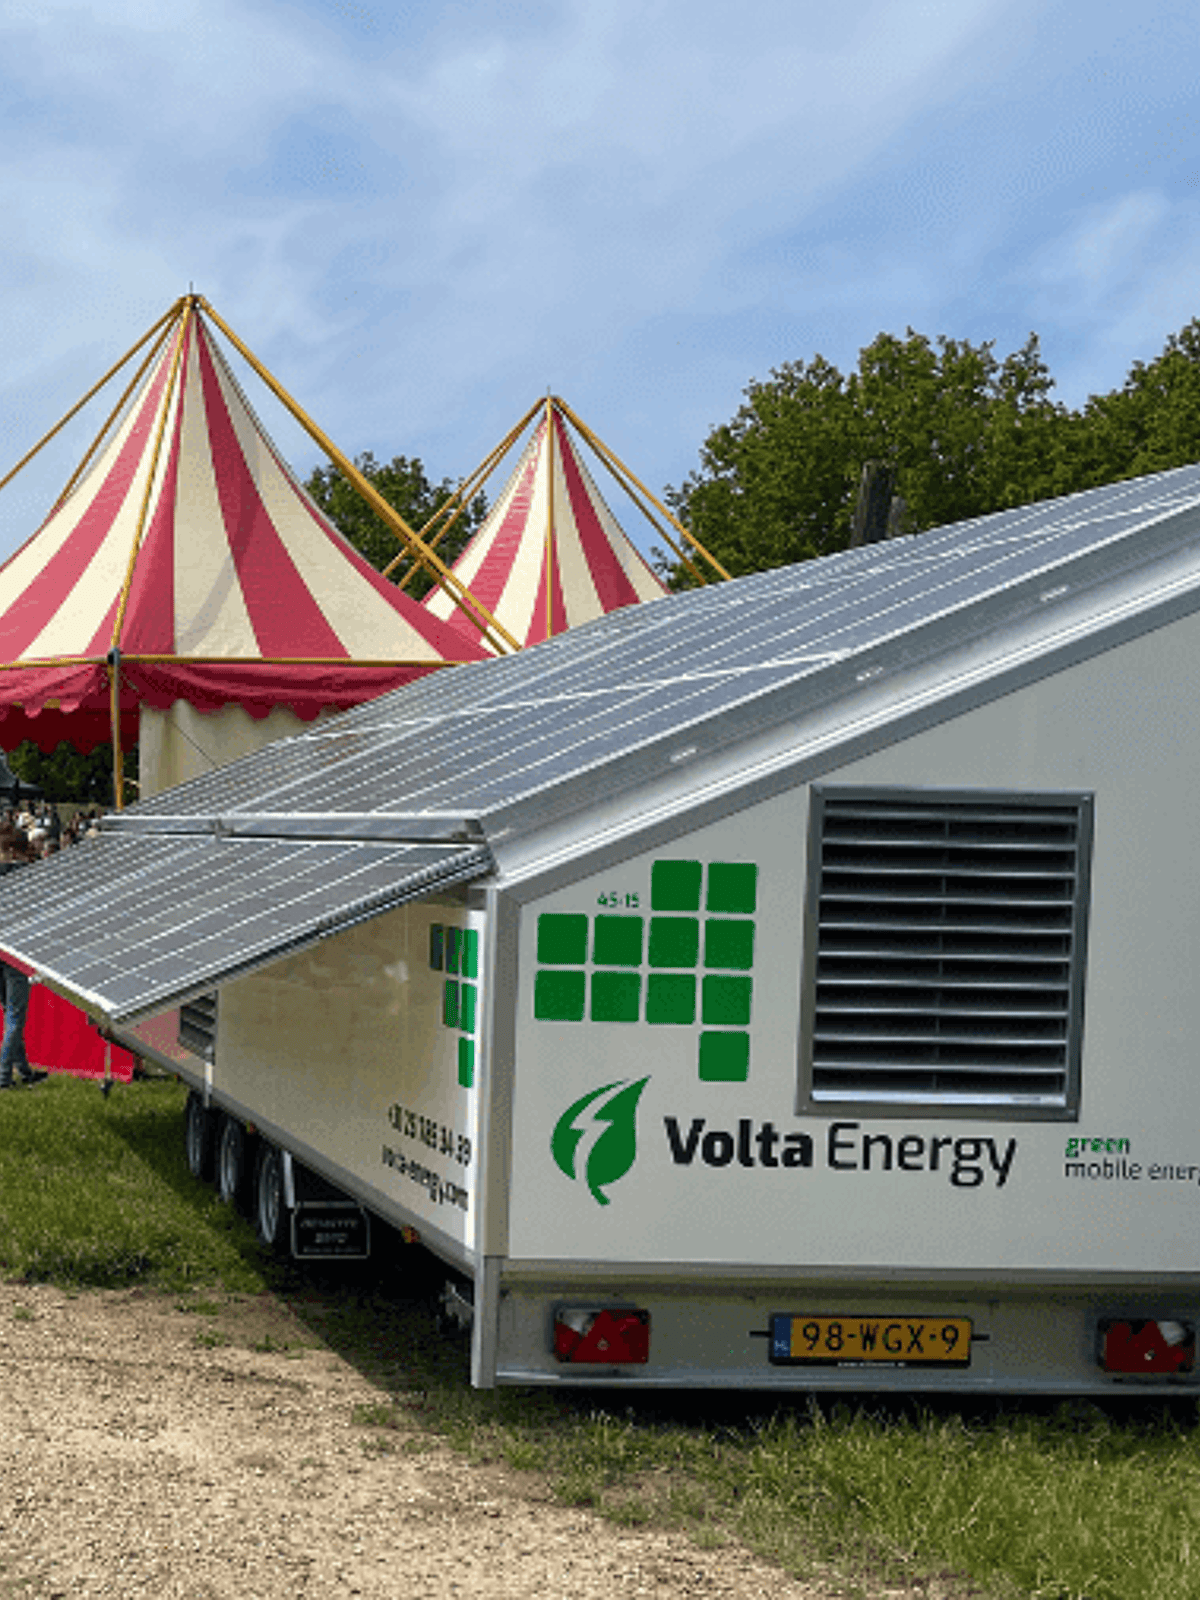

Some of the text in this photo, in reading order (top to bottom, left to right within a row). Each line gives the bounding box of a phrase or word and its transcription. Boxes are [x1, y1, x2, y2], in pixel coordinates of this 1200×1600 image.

[664, 1116, 1017, 1188] Volta Energy
[1065, 1138, 1130, 1158] green
[1065, 1157, 1200, 1187] mobile ener
[803, 1321, 959, 1355] 98-WGX-9
